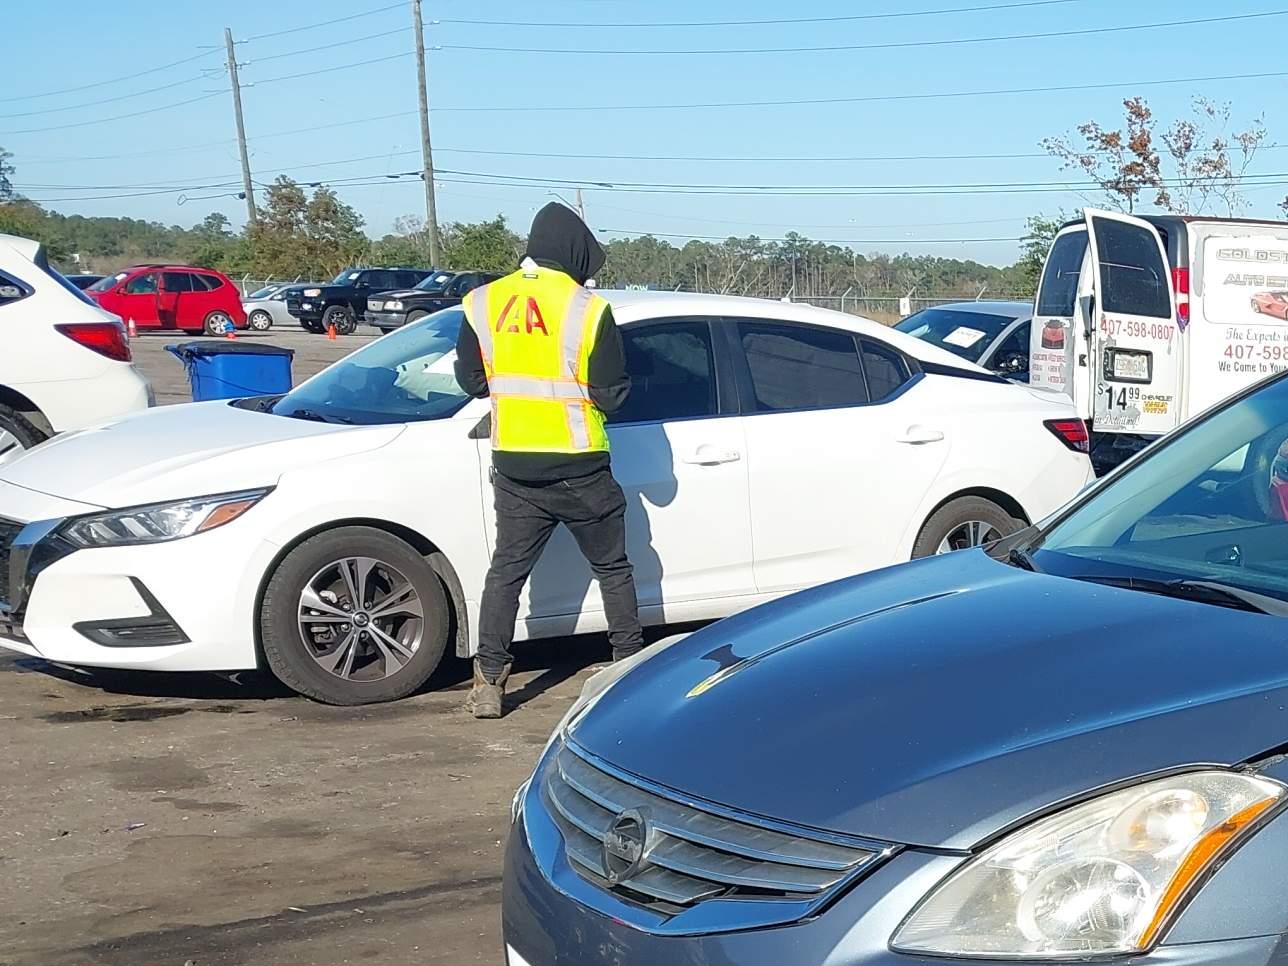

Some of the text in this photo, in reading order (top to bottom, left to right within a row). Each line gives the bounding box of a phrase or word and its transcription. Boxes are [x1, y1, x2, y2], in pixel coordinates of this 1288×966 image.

[1223, 273, 1265, 287] AUTO
[1099, 319, 1174, 340] 407-598-0807
[1225, 327, 1243, 341] The
[1246, 328, 1281, 345] Experts
[1218, 361, 1231, 372] We
[1233, 361, 1256, 374] Come
[1259, 363, 1267, 373] to
